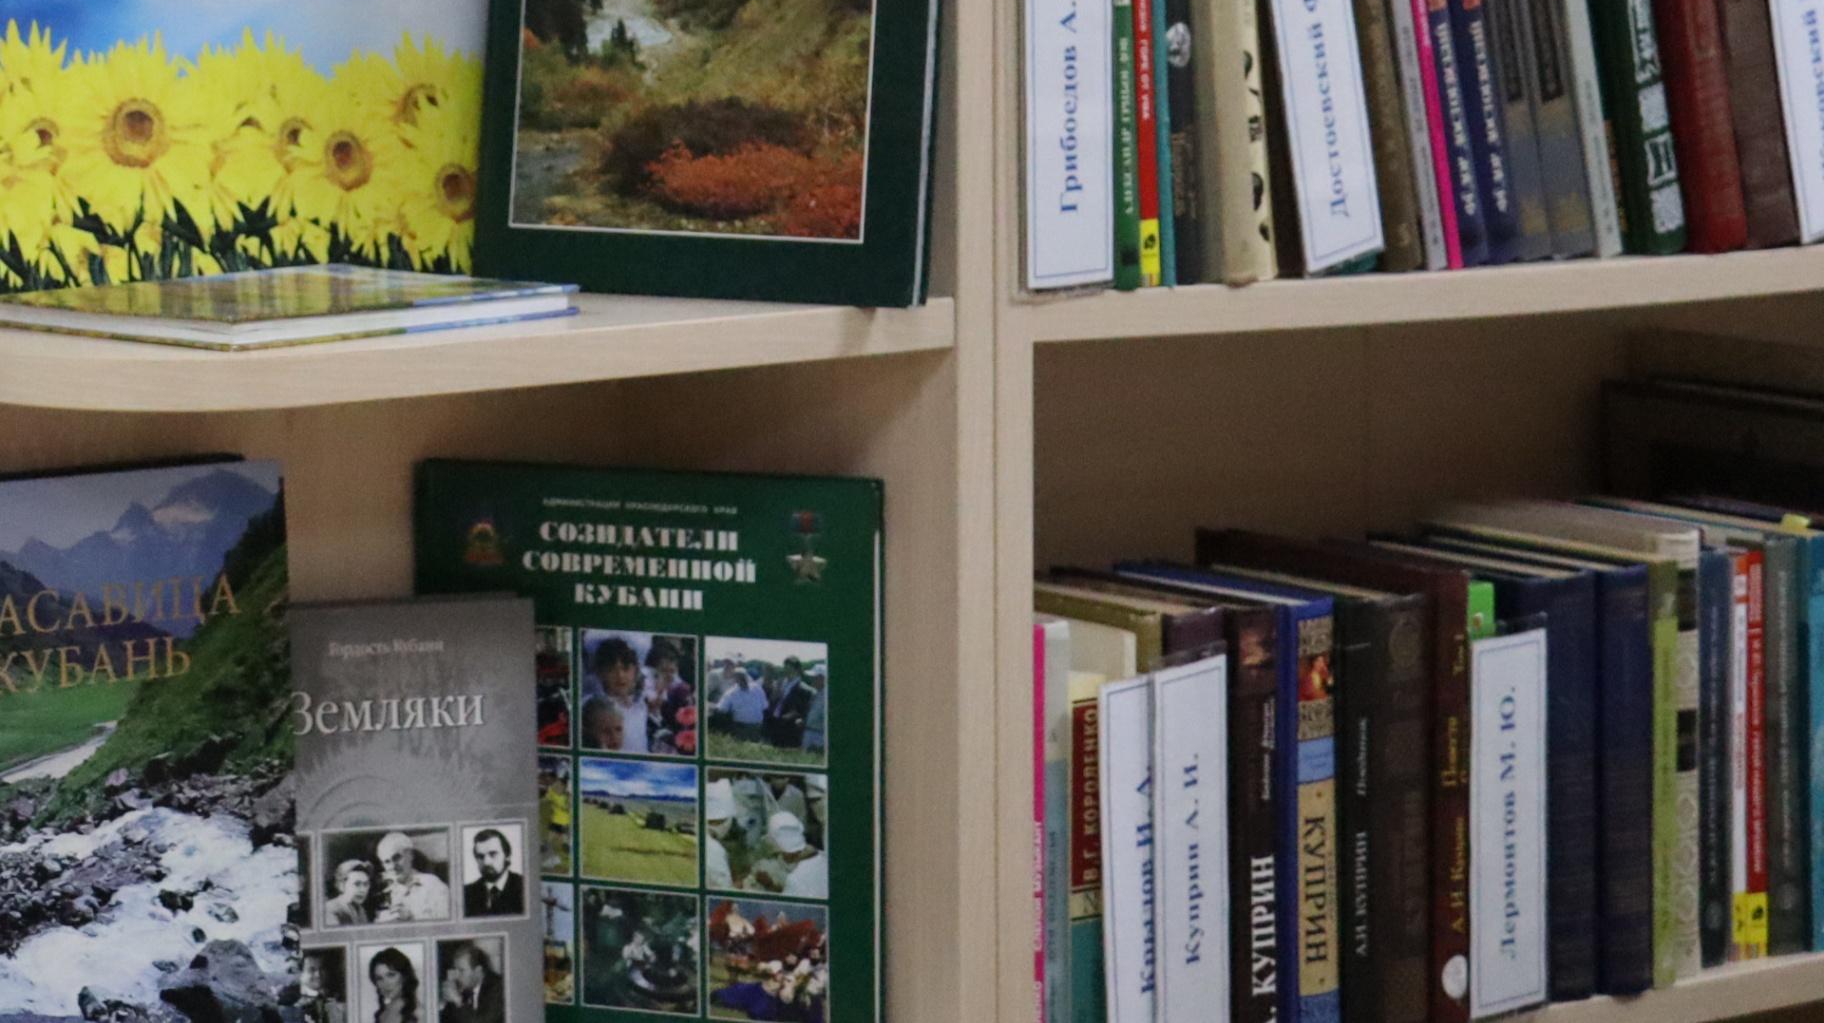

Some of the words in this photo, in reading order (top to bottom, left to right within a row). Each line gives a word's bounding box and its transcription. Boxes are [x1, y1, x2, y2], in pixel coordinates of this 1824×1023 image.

[1059, 0, 1077, 35] А.
[1059, 46, 1083, 215] Грибоедов
[1308, 22, 1350, 218] Достоевский
[539, 521, 739, 551] СОЗИДАТЕЛИ
[522, 550, 757, 583] СОВРЕМЕННОЙ
[575, 582, 704, 611] КУБАНИ
[290, 690, 485, 736] Земляки
[1499, 686, 1516, 732] Ю.
[1082, 708, 1098, 834] КОРОЛЕНКО
[1135, 765, 1153, 797] А.
[1183, 753, 1199, 789] И.
[1498, 742, 1516, 781] М.
[1135, 808, 1153, 847] И.
[1184, 798, 1199, 830] А.
[1304, 816, 1329, 964] КУПРИН
[1355, 832, 1367, 917] КУПРИН
[1498, 791, 1520, 960] Лермонтов
[1139, 859, 1156, 994] Крылов
[1184, 842, 1203, 965] Куприн
[1251, 855, 1276, 997] КУПРИН
